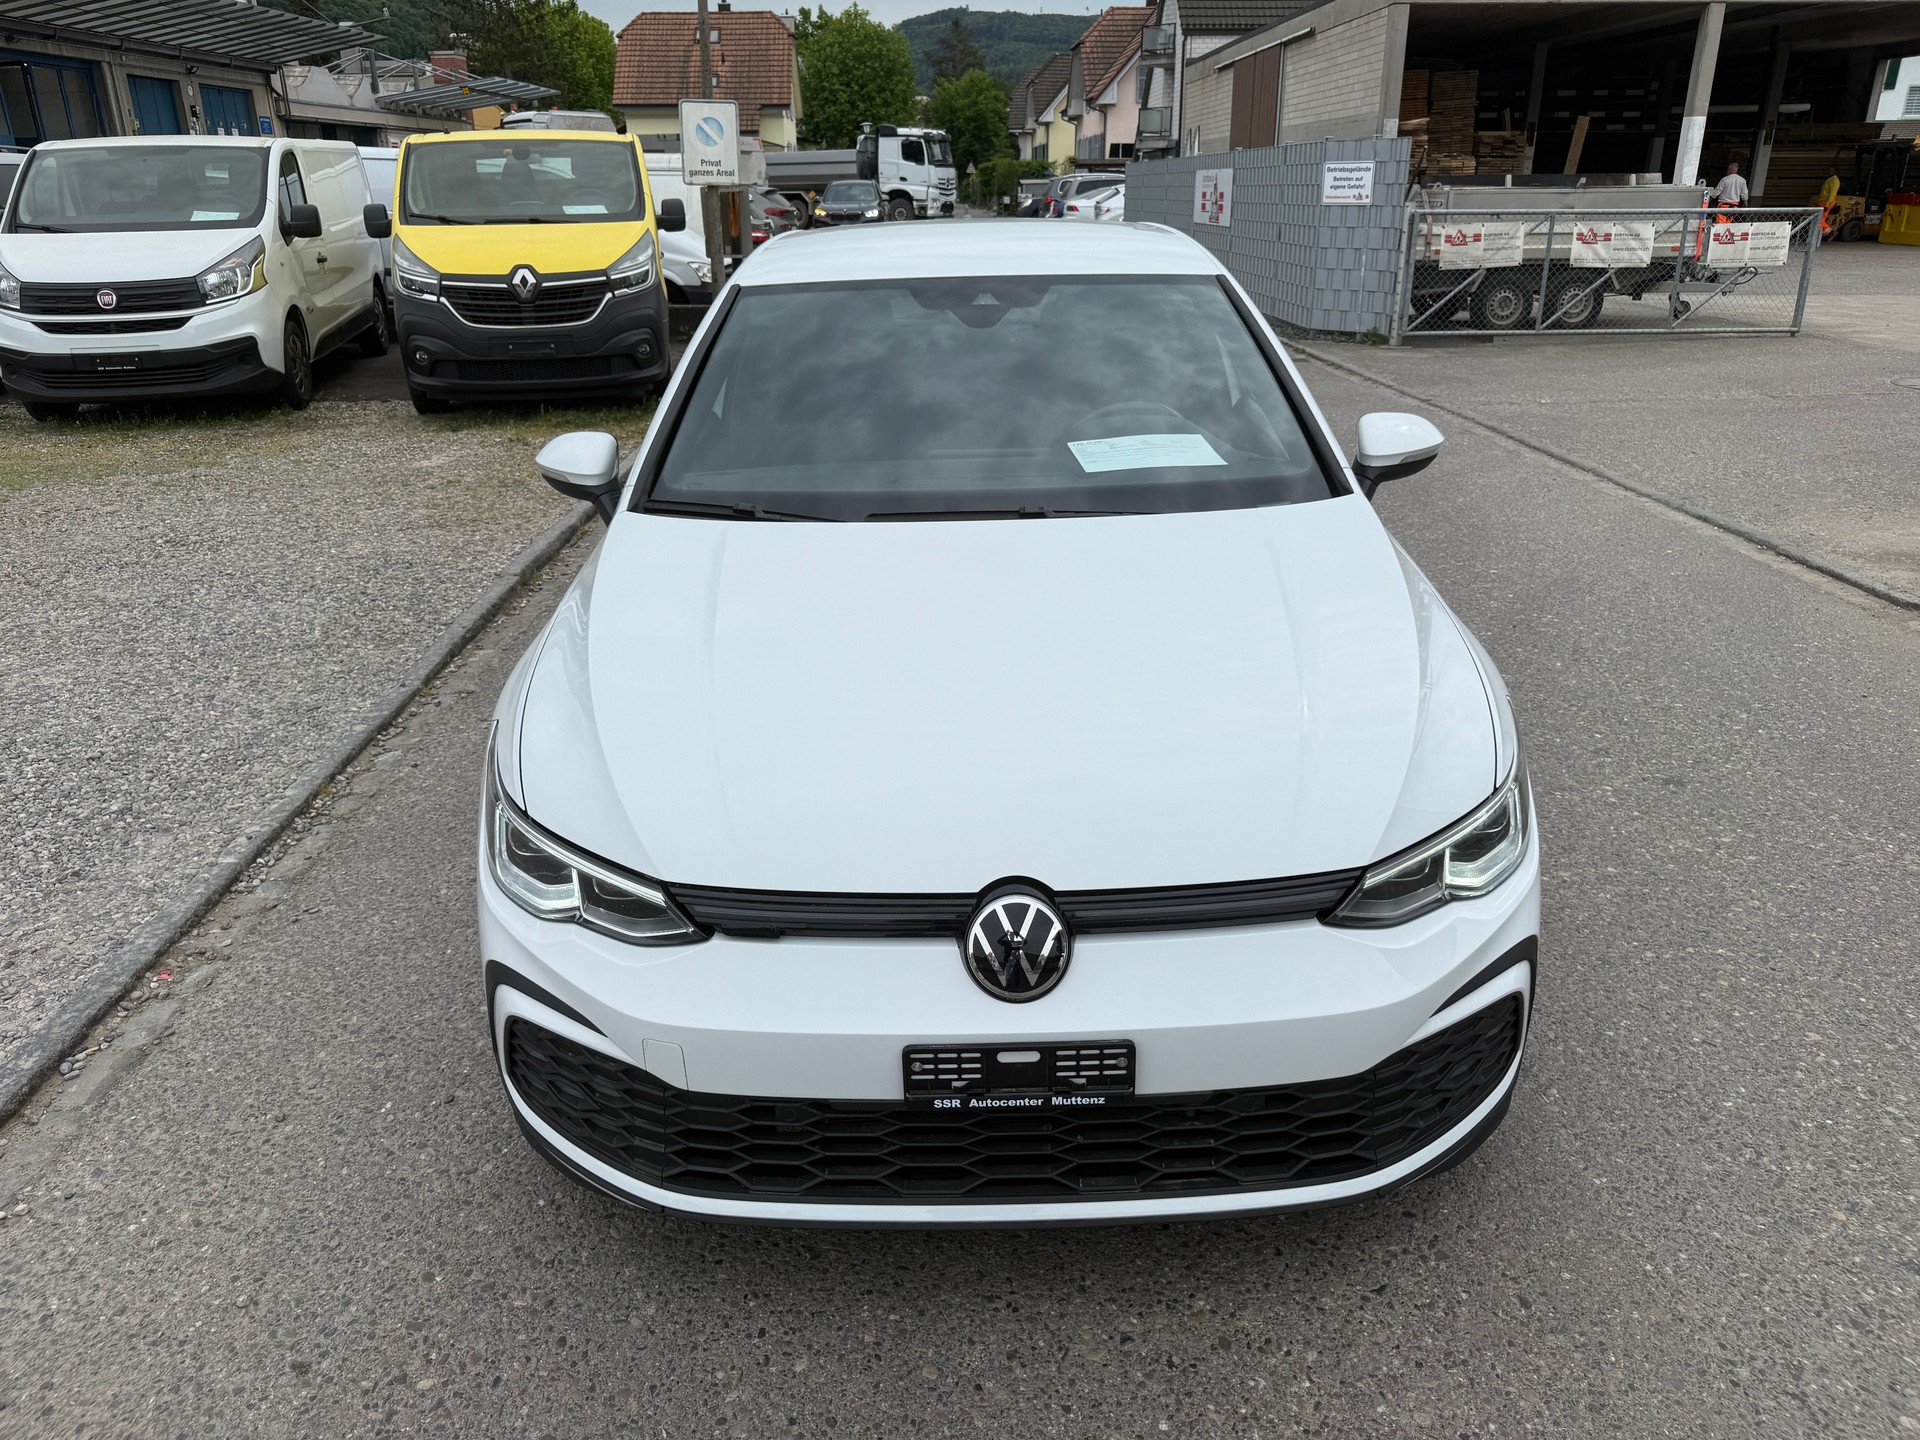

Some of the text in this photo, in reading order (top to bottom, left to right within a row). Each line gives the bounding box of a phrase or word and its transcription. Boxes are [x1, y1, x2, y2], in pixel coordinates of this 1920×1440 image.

[700, 159, 722, 167] Privat
[688, 169, 714, 178] ganzes
[101, 296, 112, 304] FIAT
[933, 1096, 1106, 1109] SSR Autocenter Muttenz
